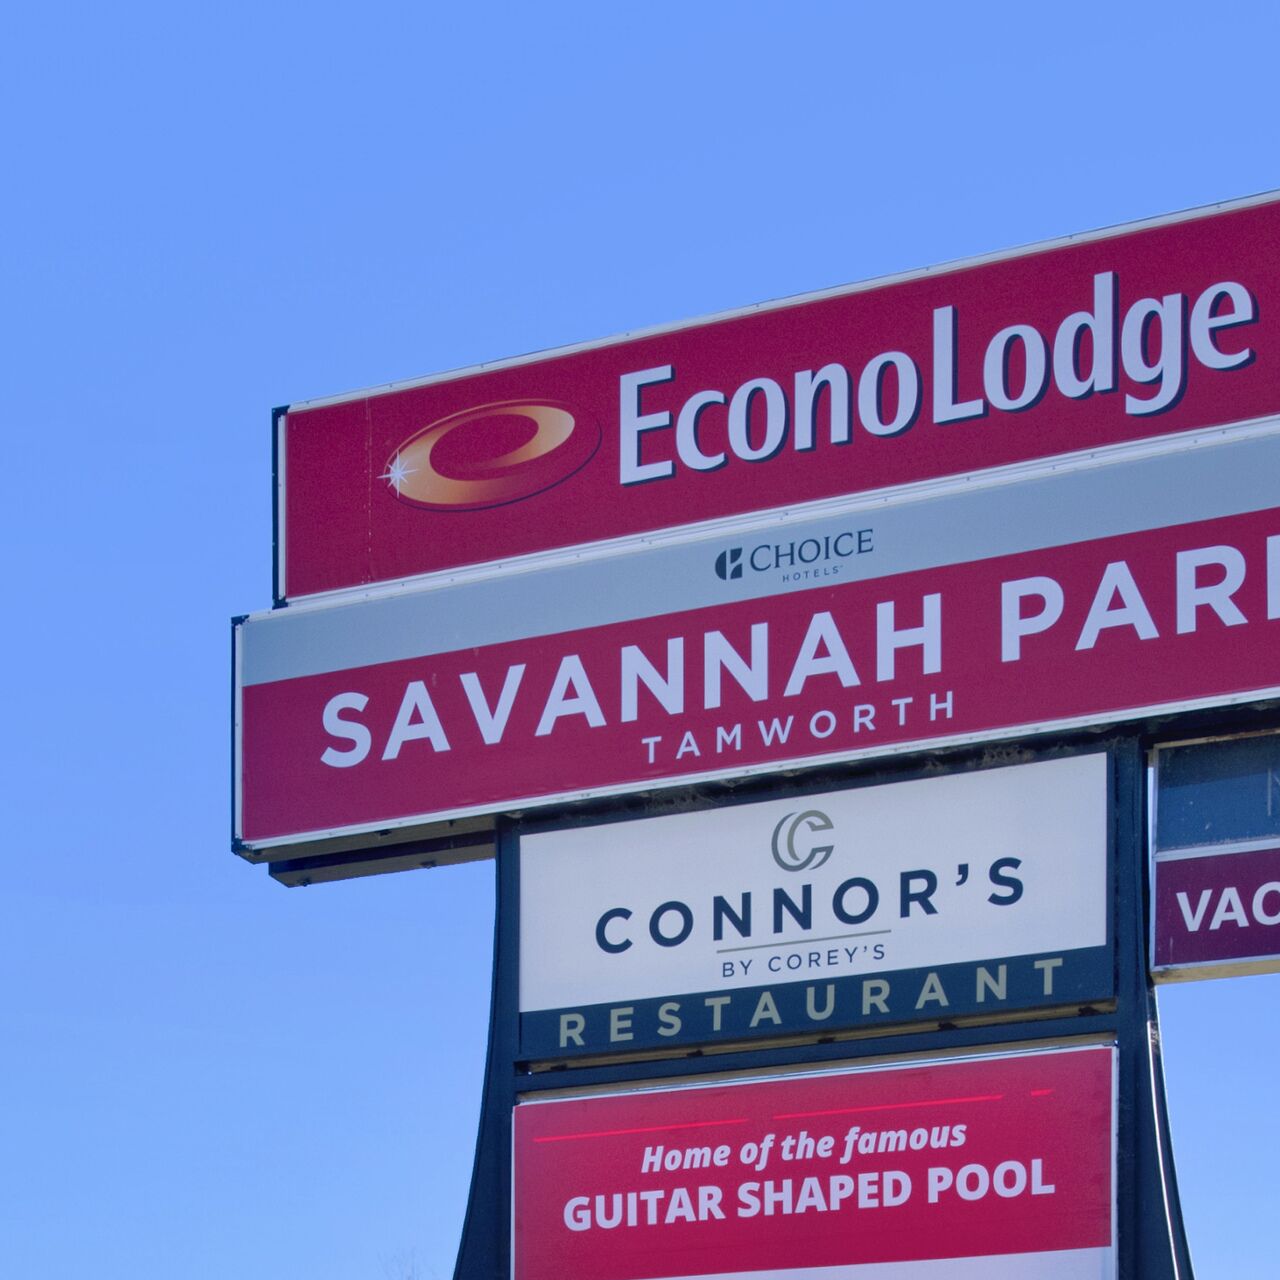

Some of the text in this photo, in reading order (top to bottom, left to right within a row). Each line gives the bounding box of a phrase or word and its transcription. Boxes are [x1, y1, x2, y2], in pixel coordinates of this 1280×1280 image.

[749, 528, 874, 572] CHOICE
[782, 565, 840, 583] HOTELS
[320, 592, 943, 768] SAVANNAH
[641, 690, 953, 764] TAMWORTH
[595, 856, 1025, 954] CONNOR'S
[722, 943, 886, 978] BY COREY'S
[559, 958, 1063, 1047] RESTAURANT
[640, 1124, 968, 1174] Home of the famous
[563, 1158, 1056, 1232] GUITAR SHAPED POOL
